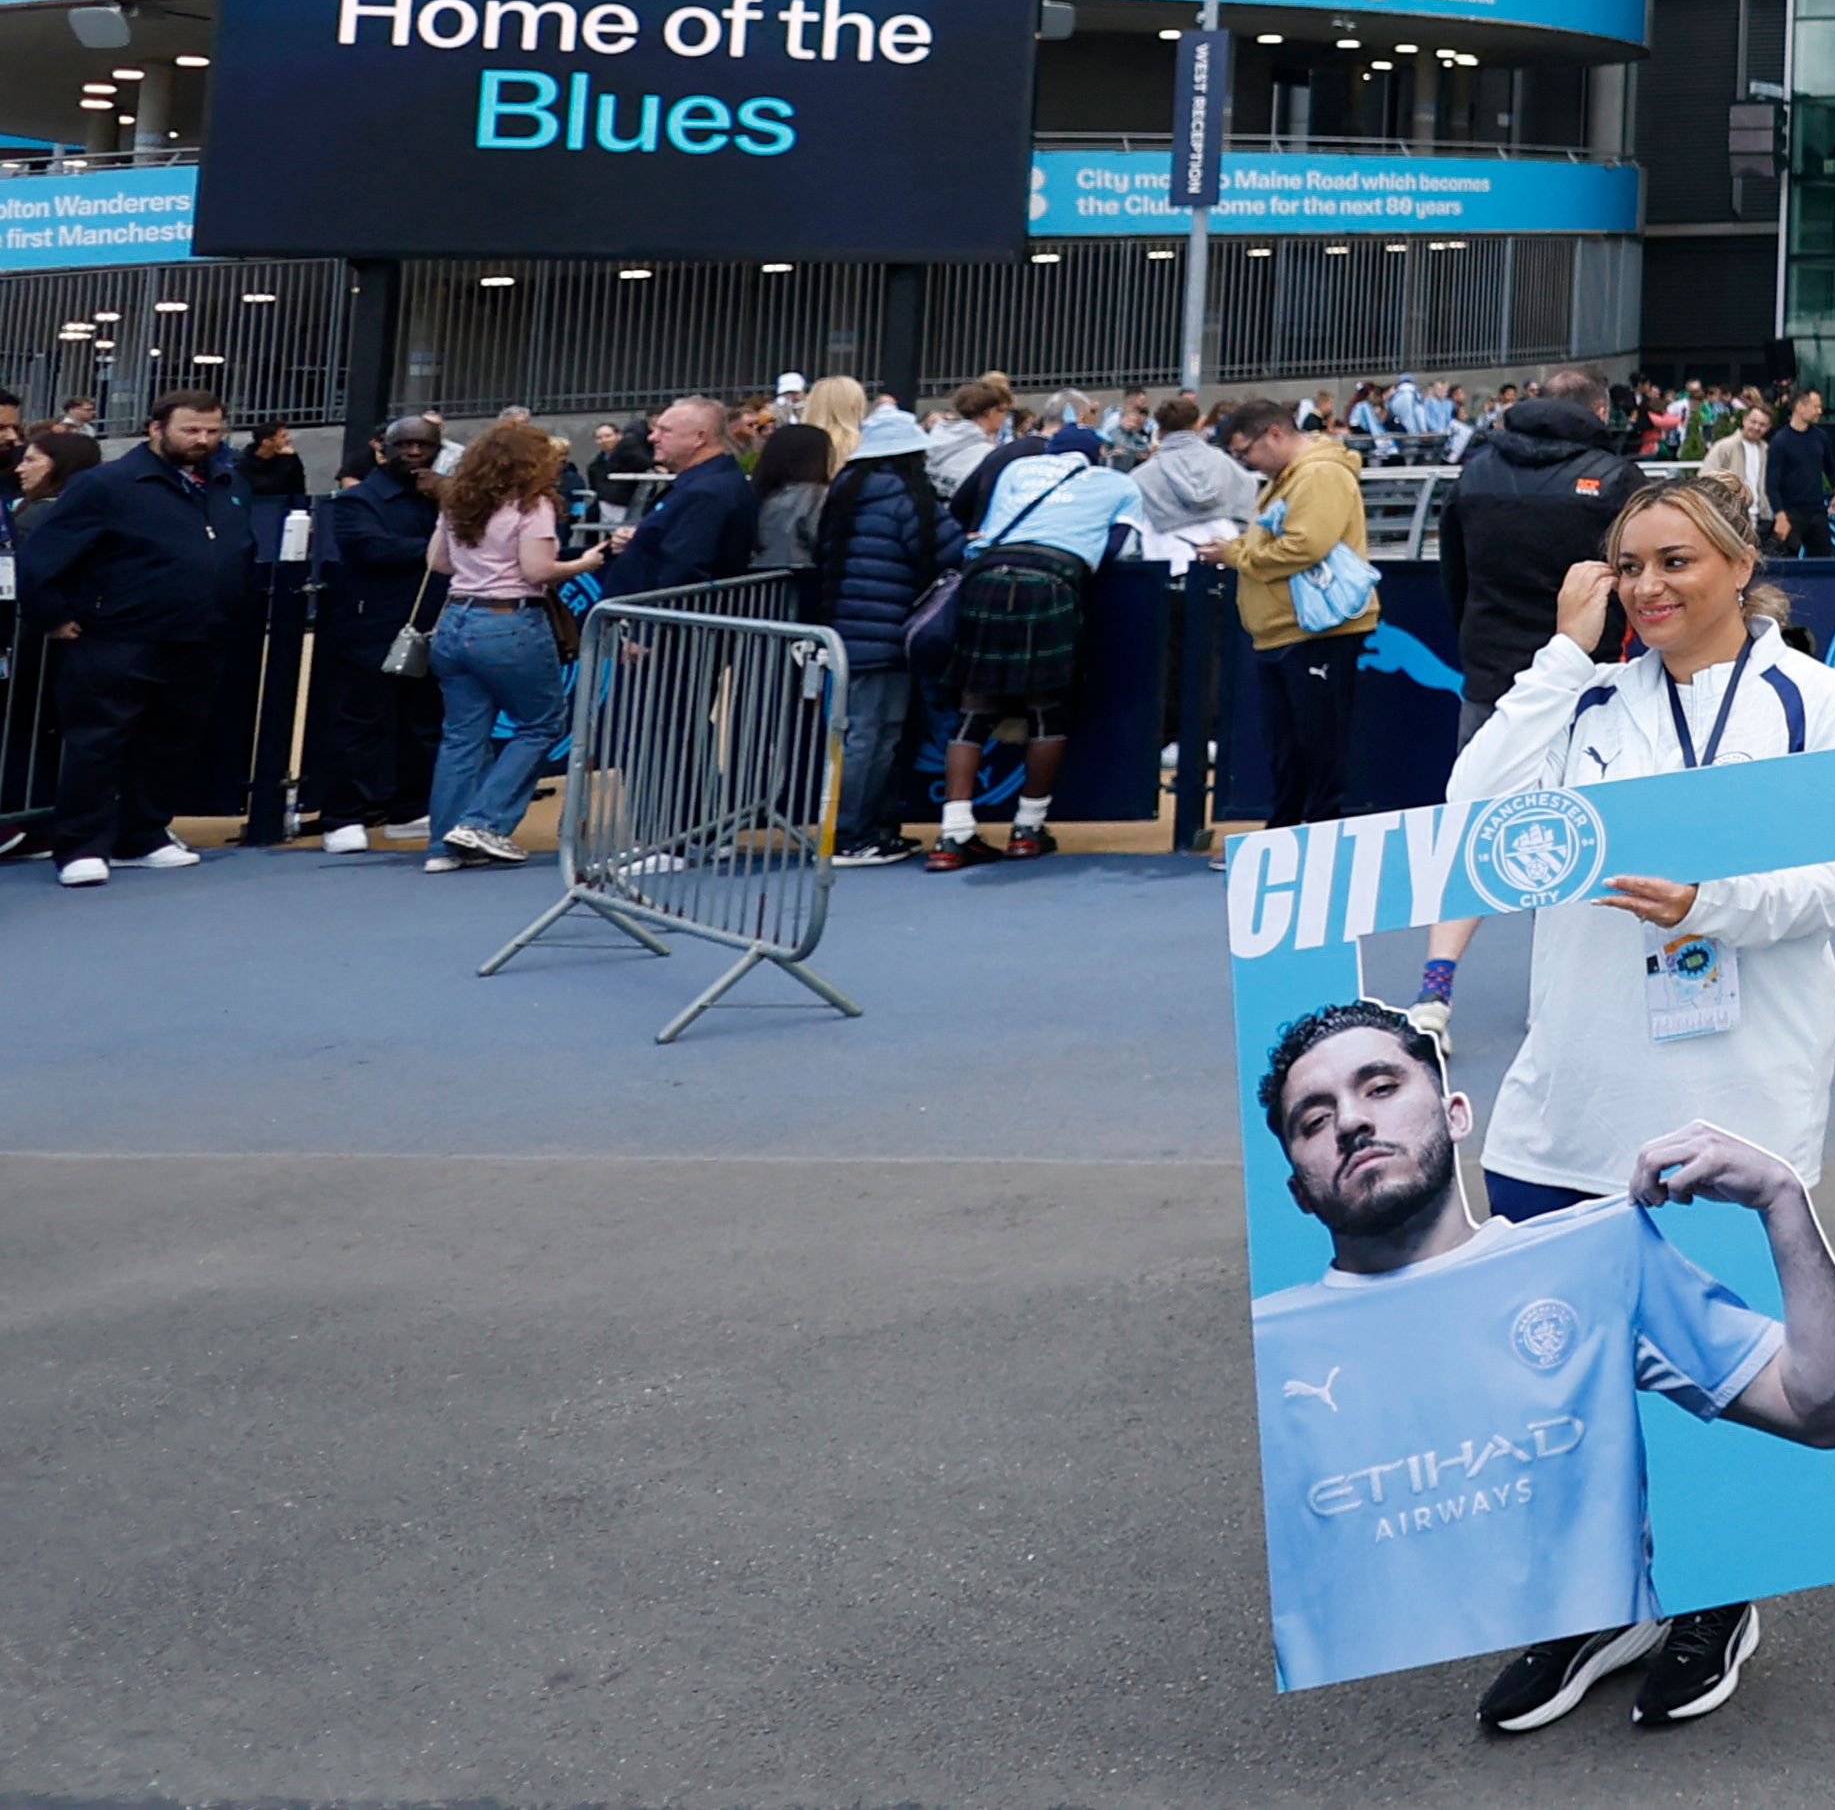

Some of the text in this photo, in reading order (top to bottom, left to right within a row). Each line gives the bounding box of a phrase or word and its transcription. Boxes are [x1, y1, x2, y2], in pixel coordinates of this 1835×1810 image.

[476, 69, 796, 156] Blues
[1187, 43, 1211, 195] WEST RECEPTION
[1076, 168, 1130, 191] City
[1235, 168, 1302, 191] Maine
[1306, 170, 1358, 192] Road
[1360, 173, 1418, 193] which
[1419, 175, 1491, 194] becomes
[55, 192, 190, 218] Wanderers
[1076, 194, 1121, 217] the
[1270, 196, 1300, 215] for
[1303, 196, 1338, 216] the
[1339, 198, 1382, 216] next
[1415, 200, 1462, 219] years
[7, 223, 53, 249] first
[1480, 793, 1587, 840] MANCHESTER
[1229, 801, 1473, 959] CITY
[1520, 890, 1559, 906] CITY
[1305, 1414, 1587, 1518] ETIHAD
[1373, 1475, 1535, 1544] AIRWAYS
